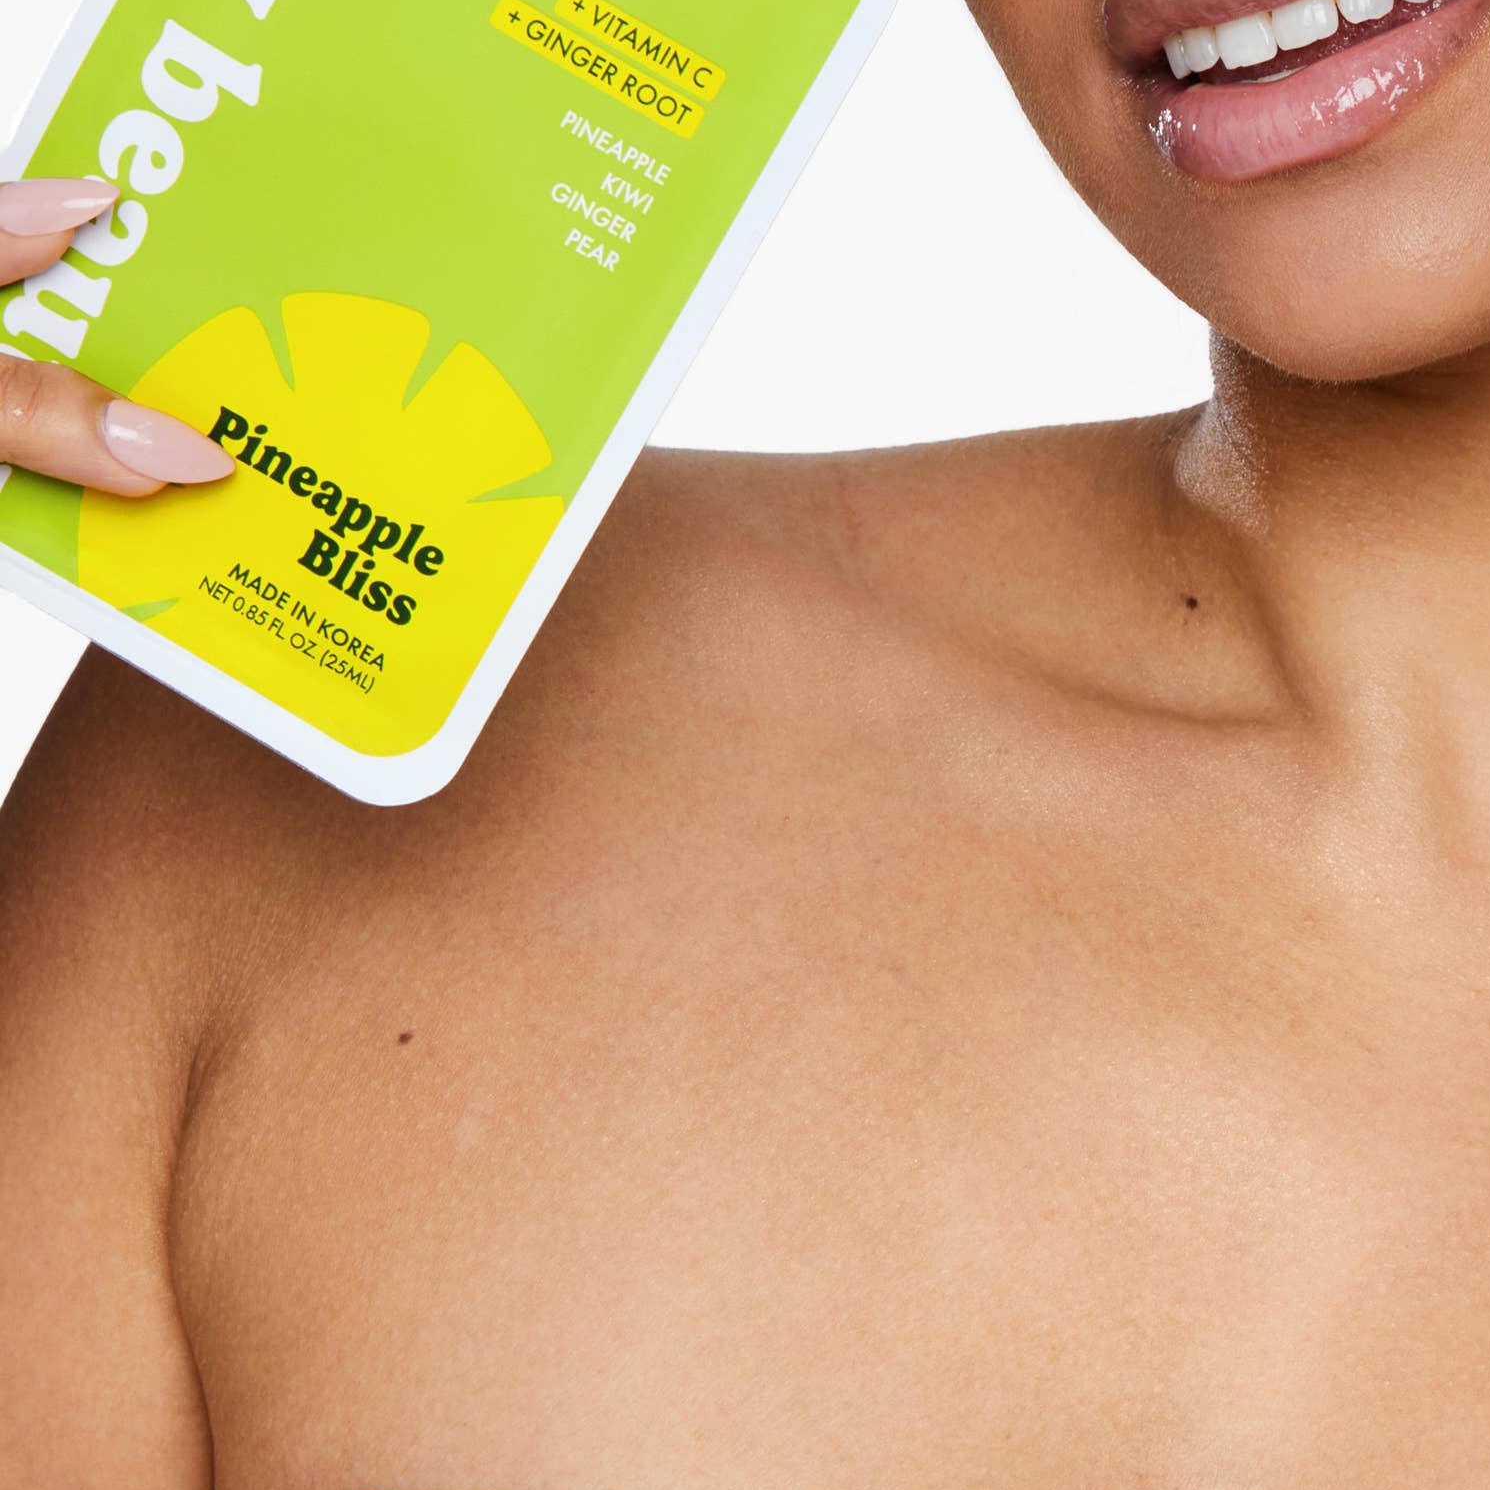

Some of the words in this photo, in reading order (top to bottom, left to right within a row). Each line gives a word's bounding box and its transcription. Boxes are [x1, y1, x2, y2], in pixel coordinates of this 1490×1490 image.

[525, 19, 618, 86] GINGER
[620, 74, 693, 125] ROOT
[593, 4, 691, 77] VITAMIN
[692, 65, 713, 89] C
[559, 109, 672, 186] PINEAPPLE
[600, 172, 654, 214] KIWI
[0, 19, 262, 493] beau
[550, 182, 637, 244] GINGER
[564, 228, 620, 273] PEAR
[206, 405, 445, 577] Pineapple
[227, 562, 291, 611] MADE
[290, 601, 317, 628] IN
[316, 617, 386, 672] KOREA
[297, 528, 418, 627] Bliss
[198, 575, 234, 605] NET
[232, 595, 270, 628] 0.85
[267, 618, 285, 641] FL
[289, 631, 317, 660] OZ.
[319, 648, 376, 695] (25ML)
